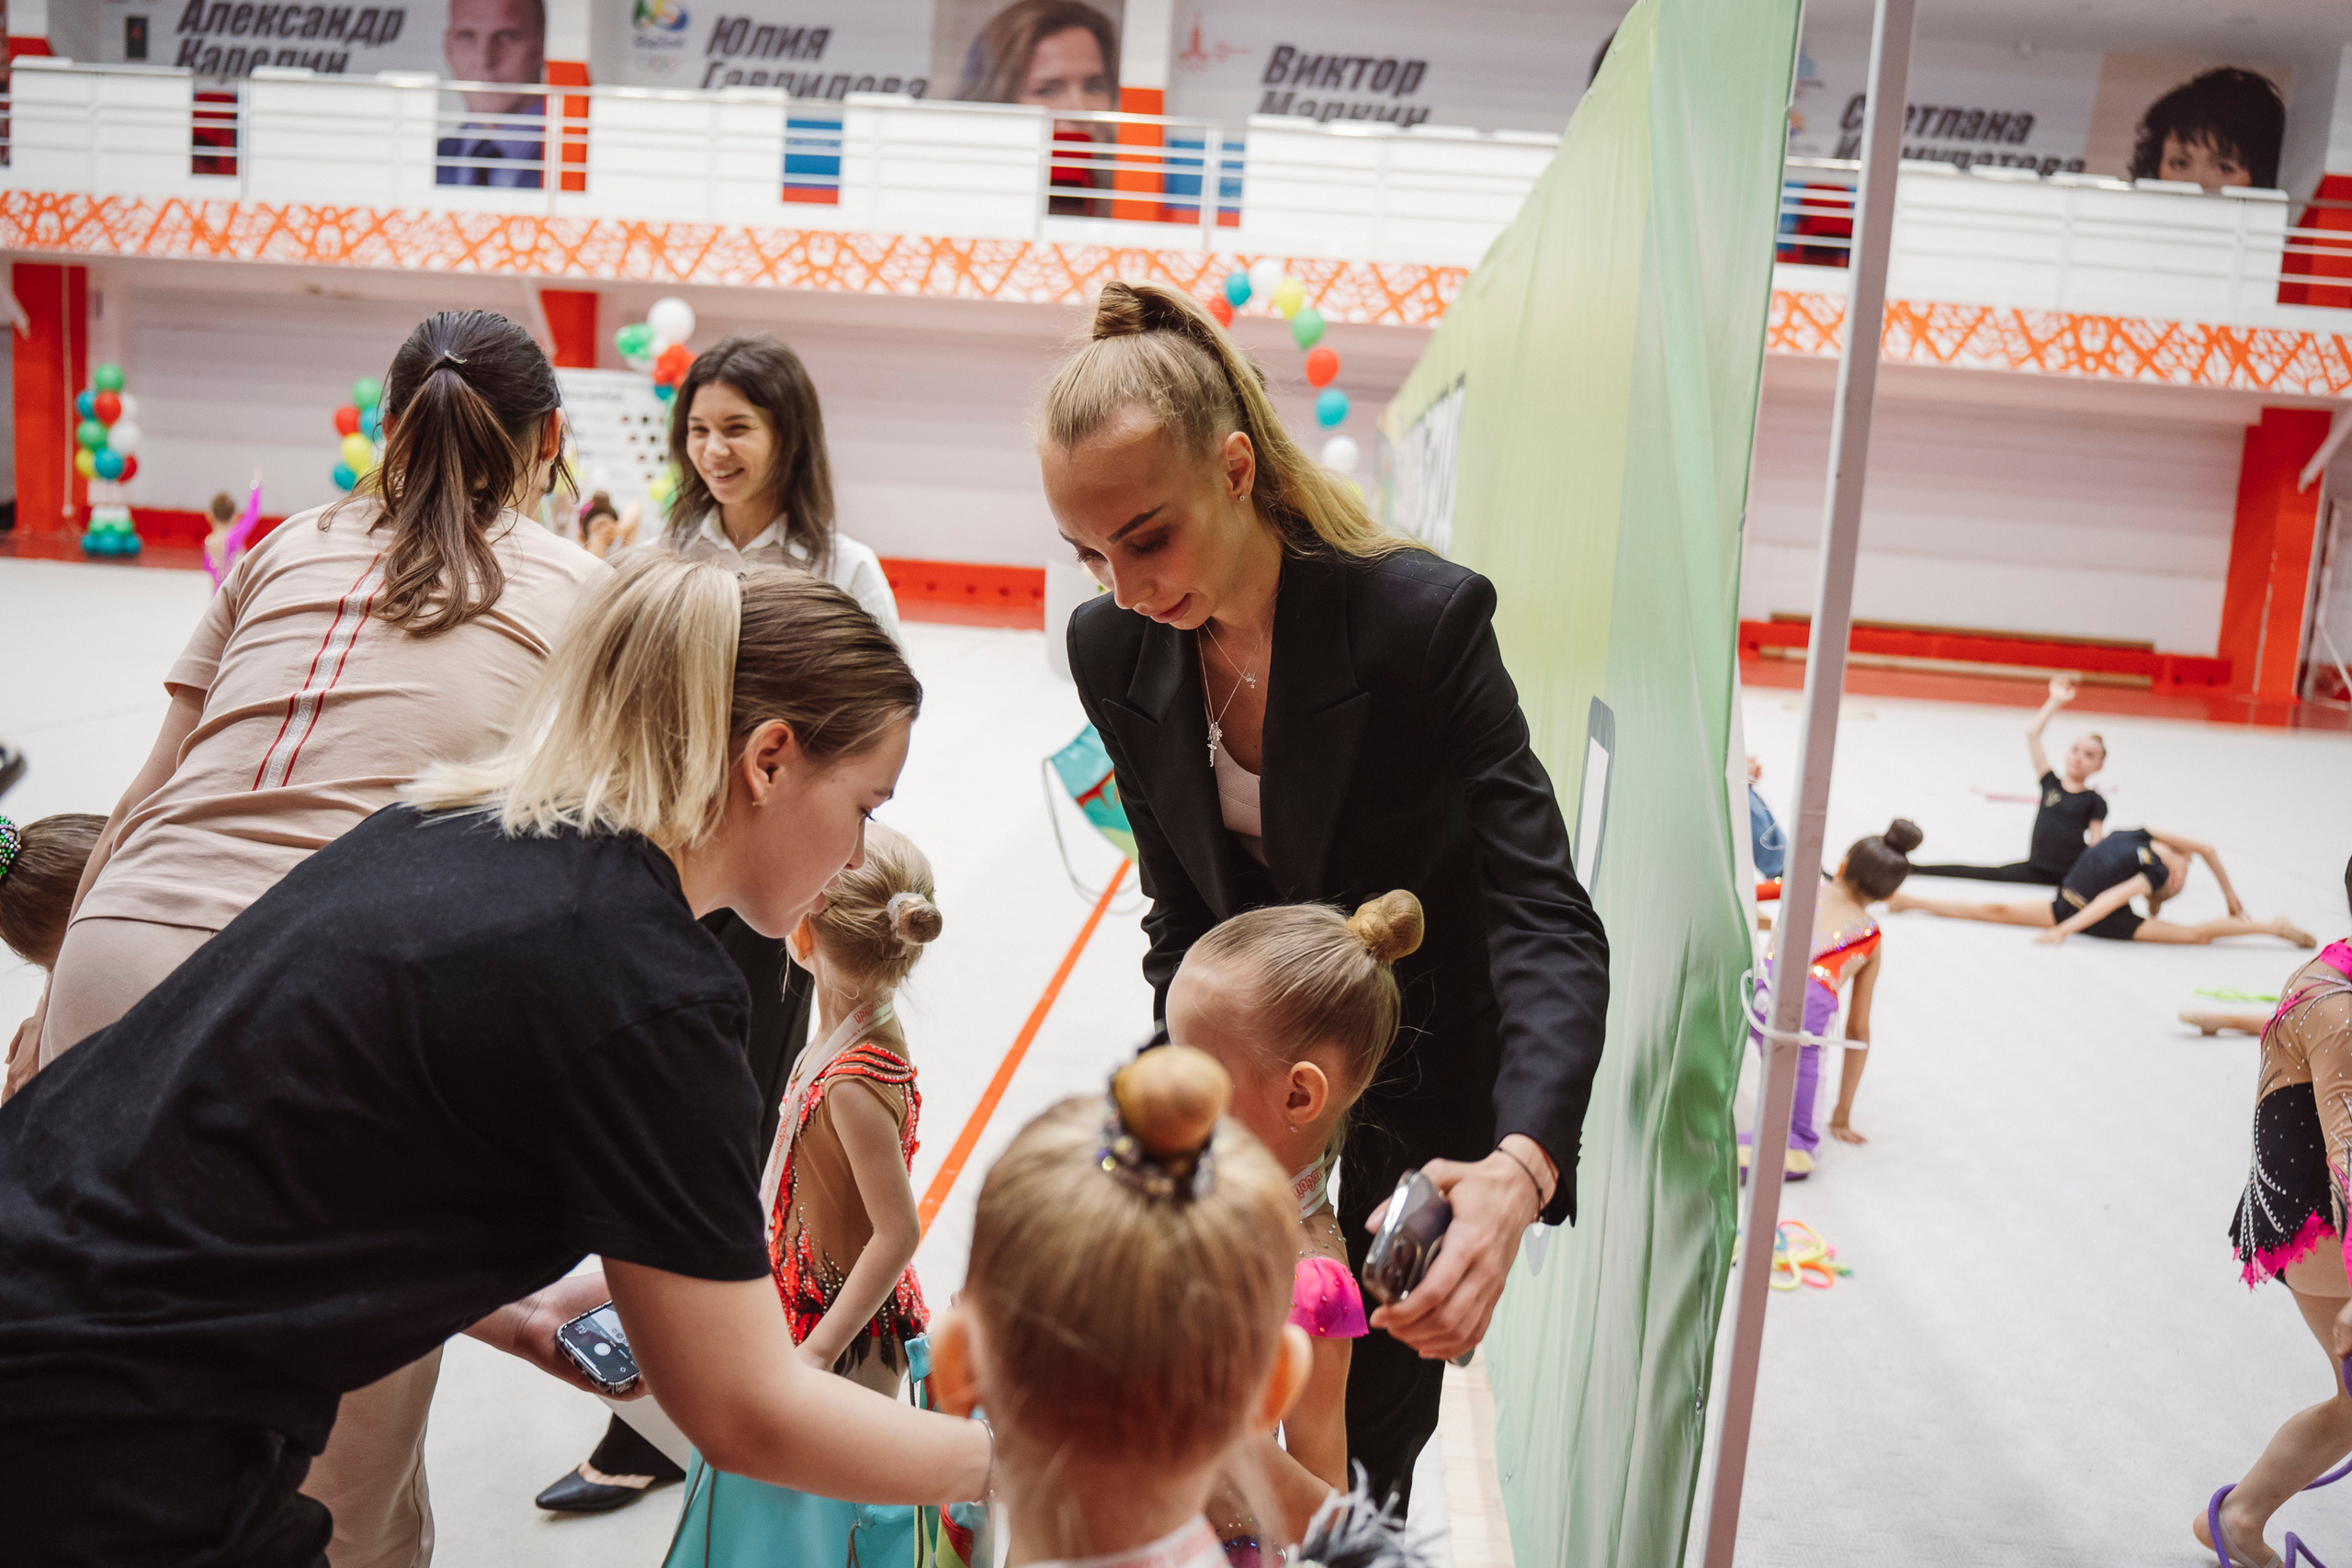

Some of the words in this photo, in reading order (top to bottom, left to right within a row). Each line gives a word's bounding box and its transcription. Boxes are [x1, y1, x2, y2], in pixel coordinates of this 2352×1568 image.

[175, 0, 407, 47] Александр
[705, 16, 831, 62] Юлия
[1261, 44, 1430, 97] Виктор
[1839, 91, 2035, 145] Стлана
